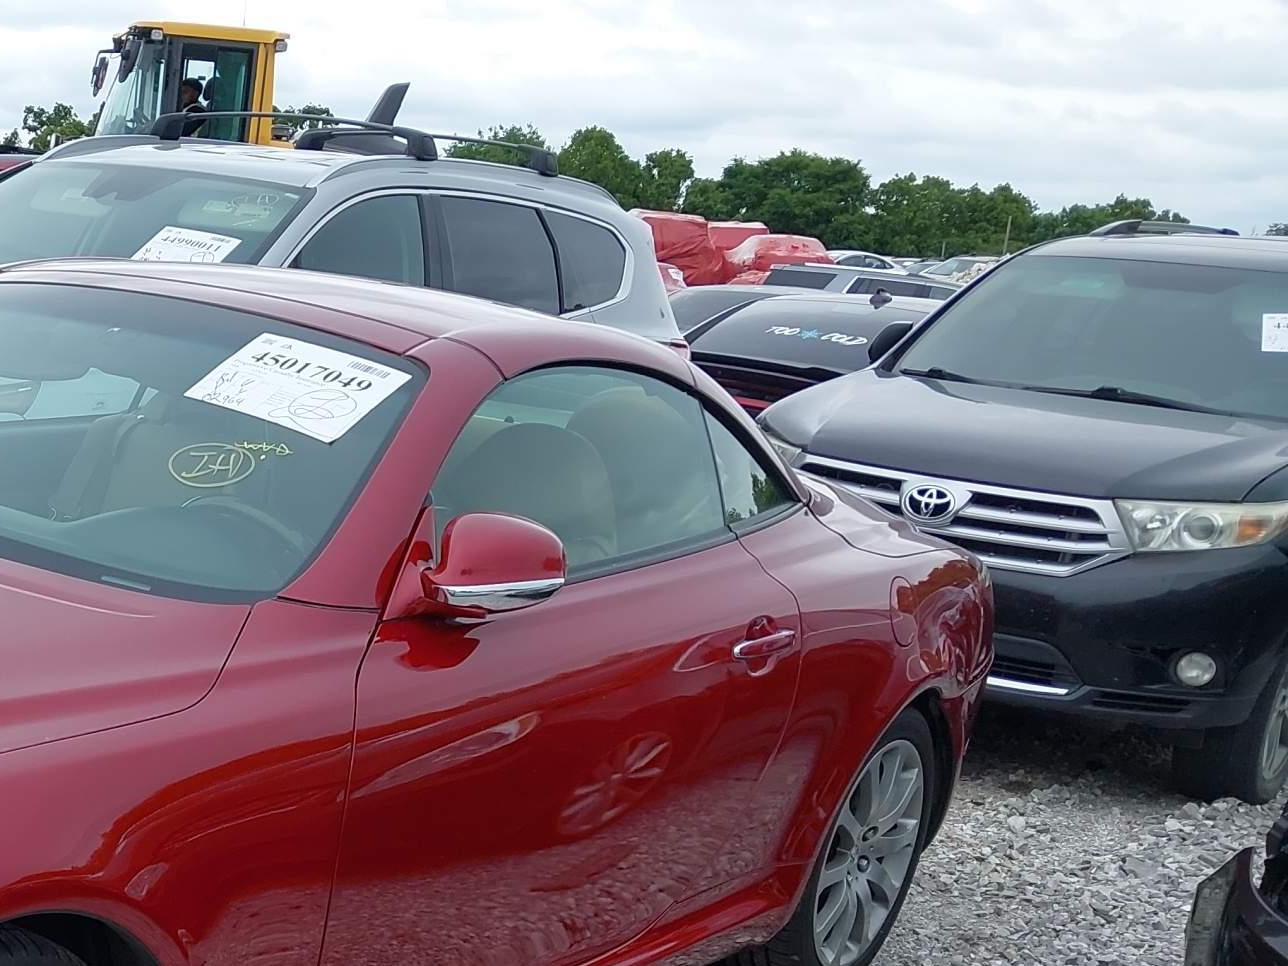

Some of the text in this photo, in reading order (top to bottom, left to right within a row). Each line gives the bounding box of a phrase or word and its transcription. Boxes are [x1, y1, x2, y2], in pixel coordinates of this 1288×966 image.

[765, 326, 868, 345] TOO COLD
[251, 352, 373, 392] 45017049
